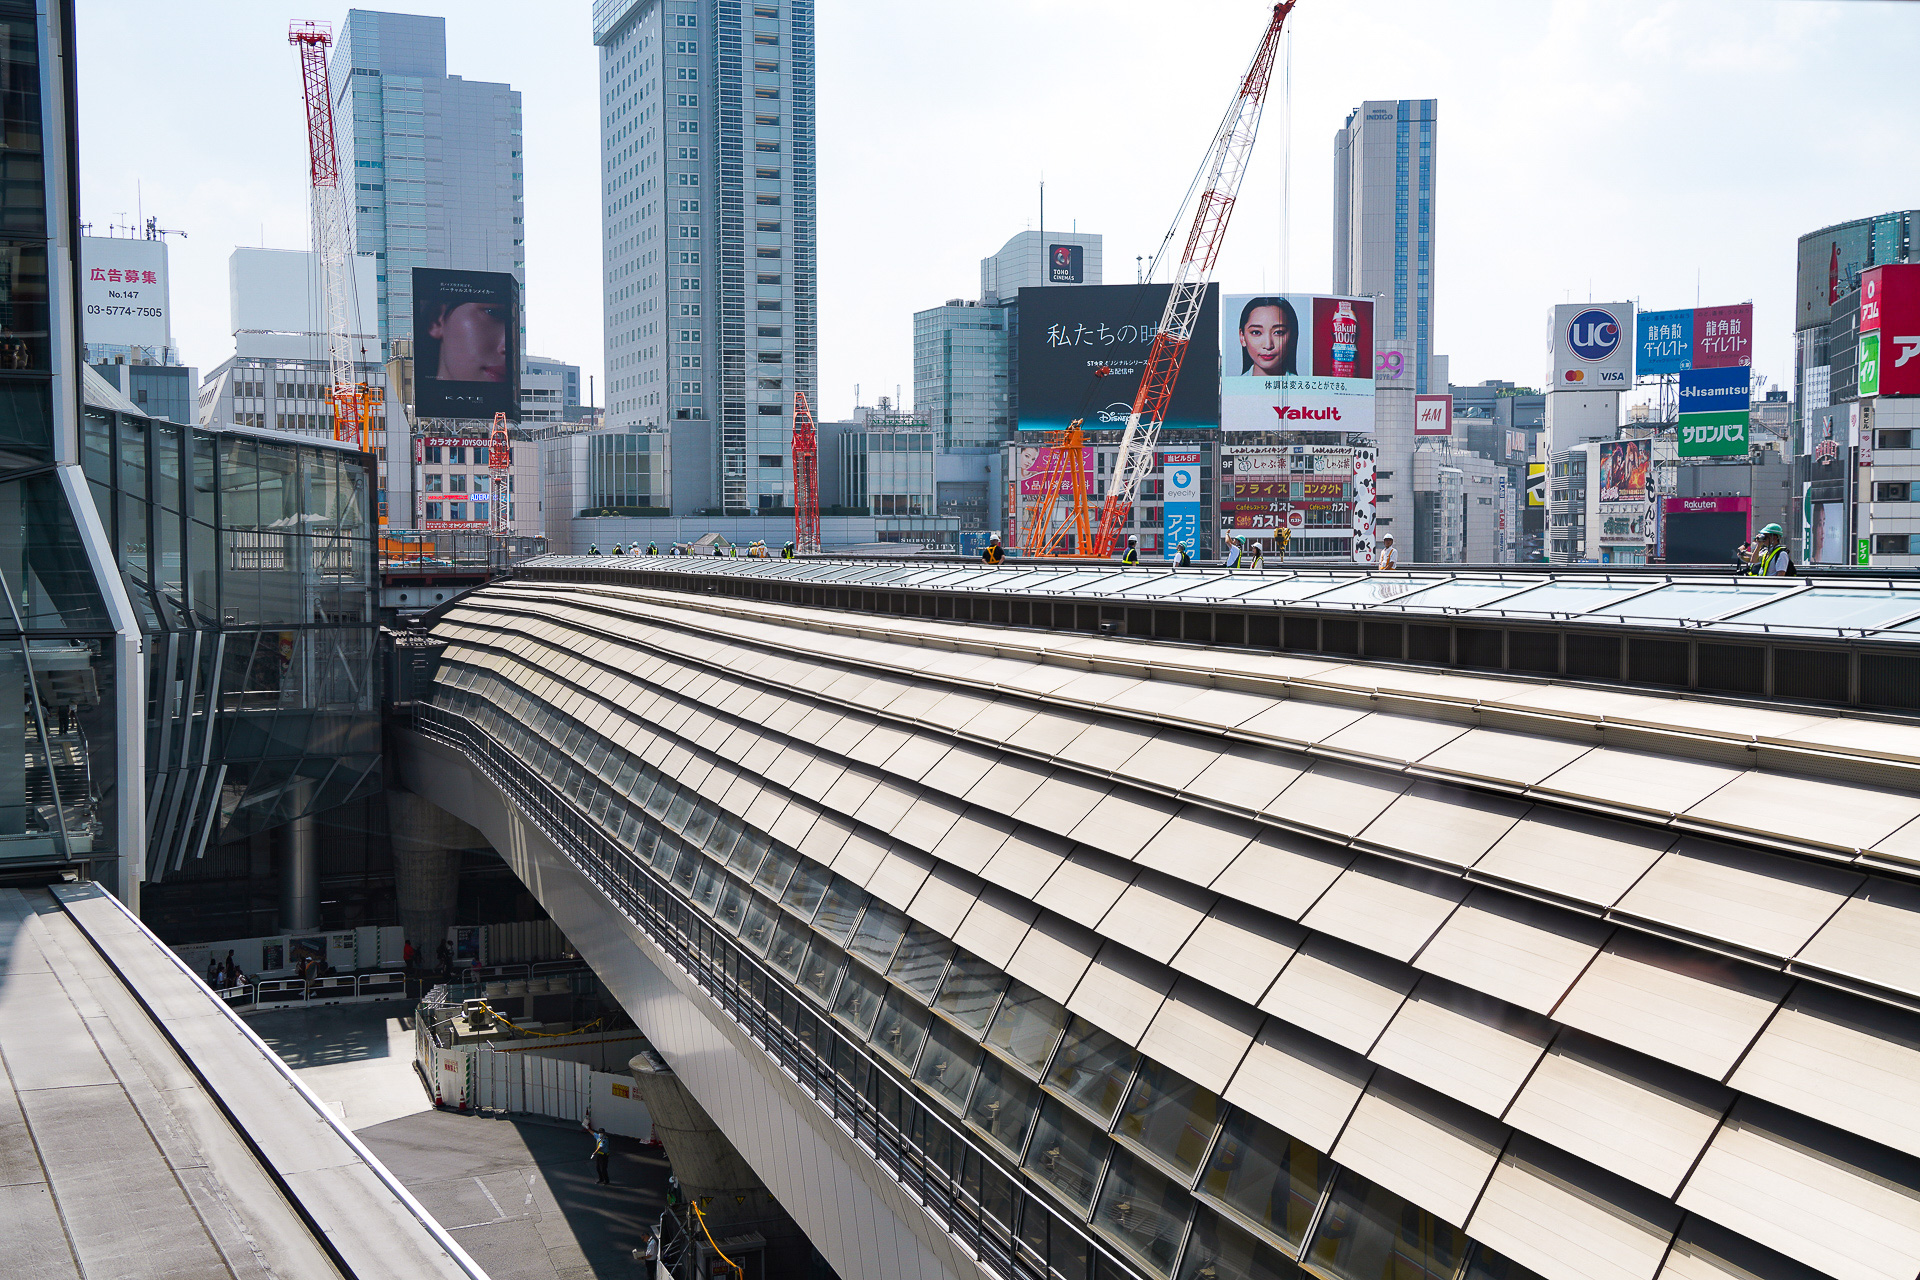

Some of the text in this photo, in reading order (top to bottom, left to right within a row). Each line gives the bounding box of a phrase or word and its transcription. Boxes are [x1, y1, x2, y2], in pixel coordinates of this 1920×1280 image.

[90, 267, 157, 284] 広告募集
[108, 290, 139, 299] No.147
[87, 304, 162, 317] 03-5774-7505
[1862, 301, 1879, 321] アコム
[1333, 322, 1356, 333] Yakult
[1648, 323, 1682, 340] 龍角散
[1706, 318, 1741, 336] 龍角散
[1046, 320, 1184, 348] 私たちの映
[1334, 331, 1356, 343] 1000
[1573, 322, 1617, 347] UC
[1643, 340, 1688, 357] ダイレクト
[1700, 336, 1748, 353] ダイレクト
[1600, 372, 1624, 381] VISA
[1265, 380, 1348, 391] 体調は変えることができる。
[1680, 386, 1749, 397] Hisamitsu
[1272, 405, 1342, 421] Yakult
[1421, 408, 1442, 422] H&M
[1682, 424, 1744, 443] サロンパス
[430, 437, 460, 446] カラオケ
[1230, 446, 1289, 454] しゃぶしゃぶバイキング
[1167, 454, 1197, 462] 当ビル5F
[1253, 458, 1287, 469] しゃぶ葉
[1326, 458, 1350, 469] しゃぶ葉
[1222, 460, 1233, 469] 9F
[1167, 489, 1196, 498] eyecity
[1235, 484, 1288, 494] プライス
[1305, 484, 1342, 494] コンタクト
[1269, 502, 1295, 512] ガスト
[1331, 502, 1350, 512] ガスト
[1644, 472, 1656, 542] もんじゃ
[1684, 500, 1717, 509] Rakuten
[1222, 516, 1234, 525] 7F
[1252, 514, 1284, 528] ガスト
